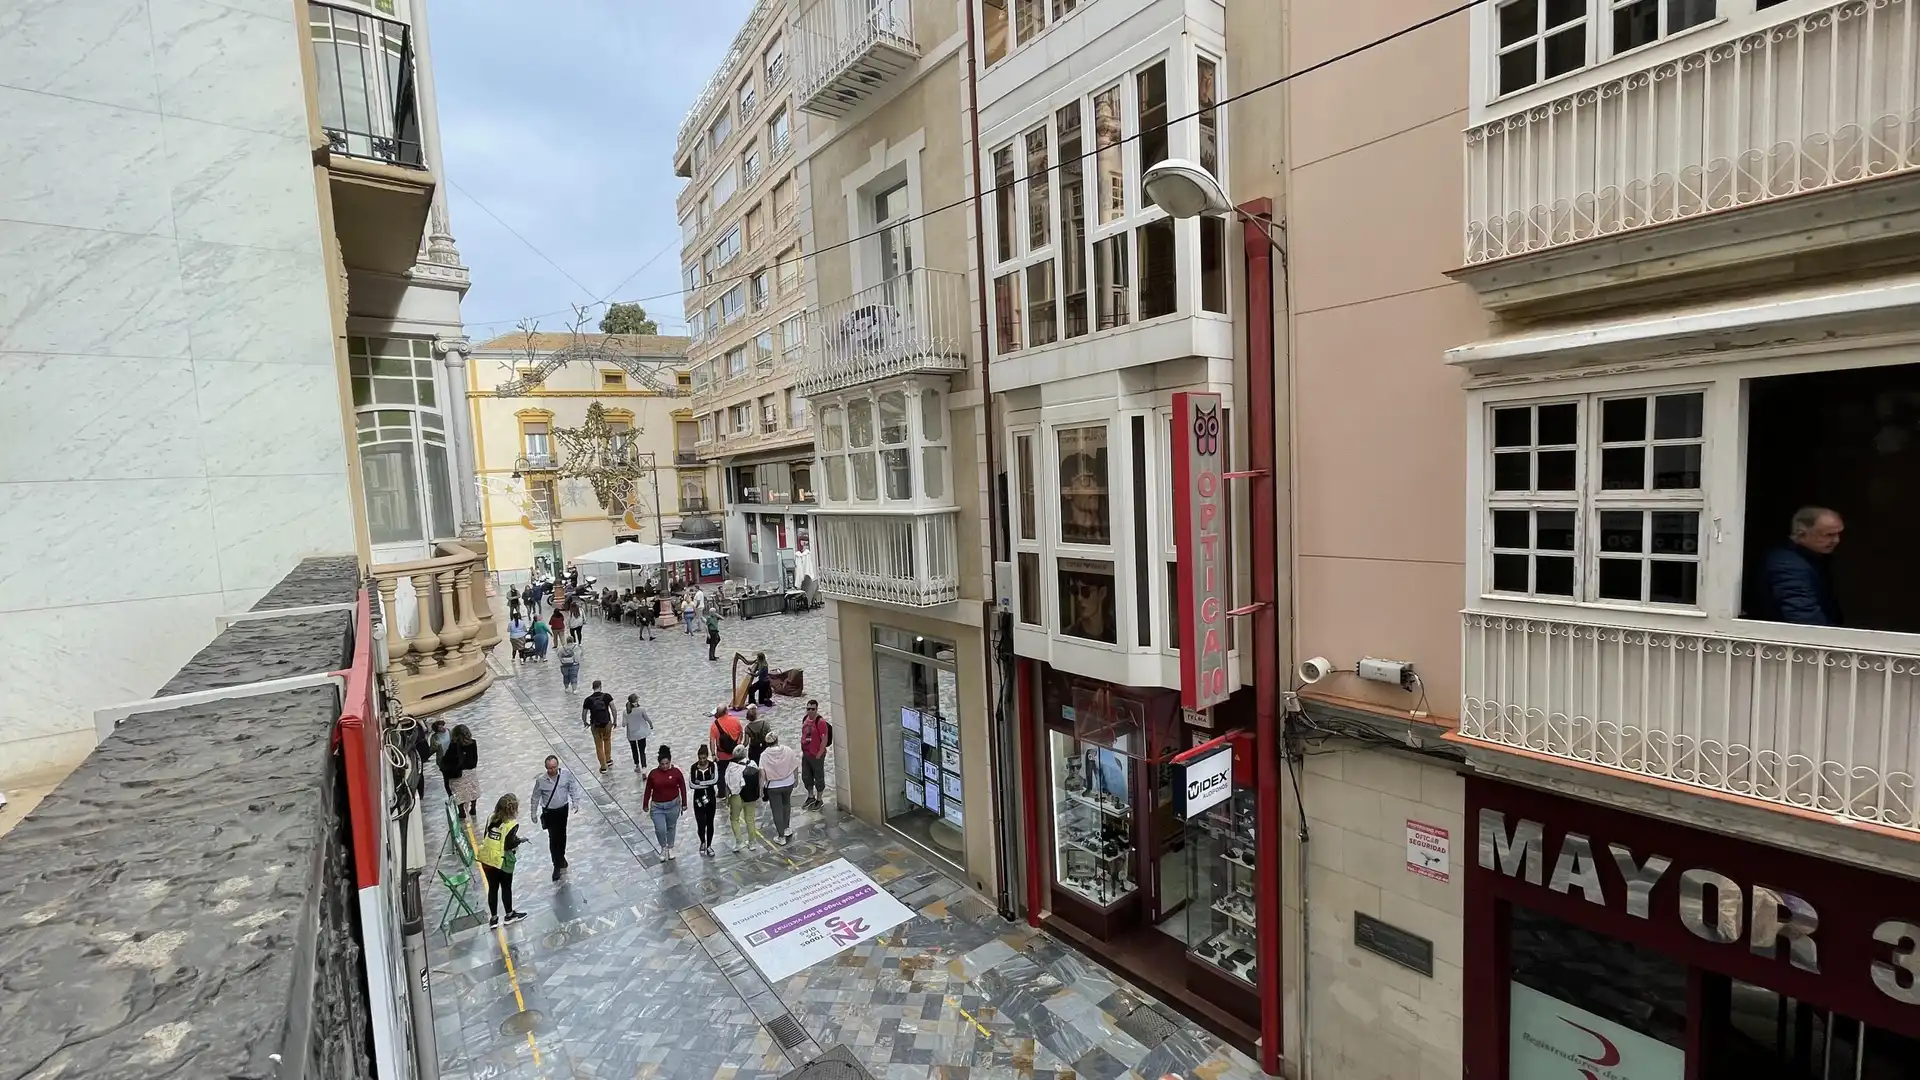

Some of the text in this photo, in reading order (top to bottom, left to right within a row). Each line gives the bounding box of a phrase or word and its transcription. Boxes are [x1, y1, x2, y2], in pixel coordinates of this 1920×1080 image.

[1198, 471, 1222, 657] OPTICA
[1201, 666, 1224, 700] 10
[1188, 769, 1228, 800] WIDEX
[1408, 838, 1447, 854] SEGURIDAD
[823, 901, 841, 911] hago
[1478, 807, 1920, 1006] MAYOR 3
[732, 909, 770, 927] Violencia
[802, 912, 816, 920] soy
[799, 934, 825, 948] TODOS
[805, 930, 821, 939] LOS
[1522, 1031, 1600, 1073] Registradores
